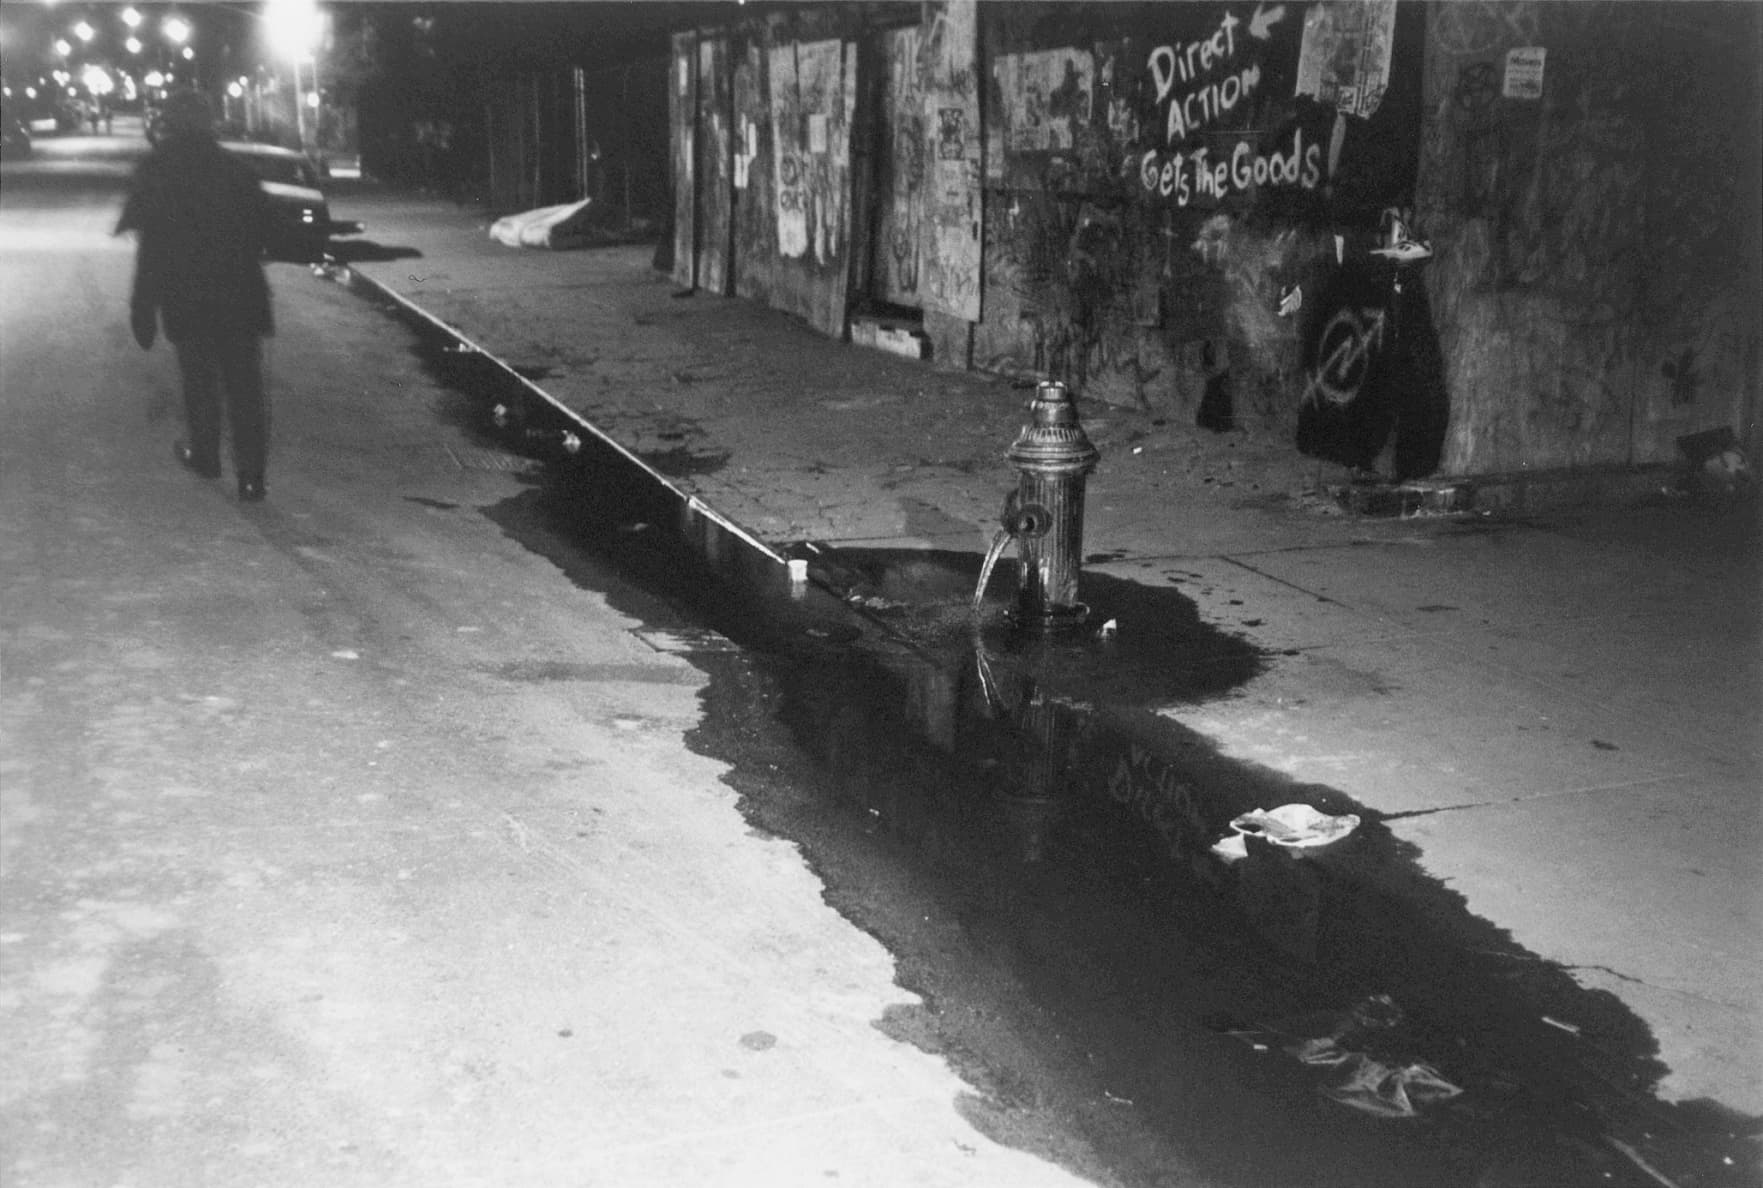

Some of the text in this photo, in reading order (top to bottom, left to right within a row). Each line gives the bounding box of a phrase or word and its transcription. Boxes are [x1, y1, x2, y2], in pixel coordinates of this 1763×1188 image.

[1147, 12, 1239, 104] Direct
[1167, 64, 1261, 143] ACTION
[1141, 149, 1190, 206] Gets
[1190, 147, 1228, 199] The
